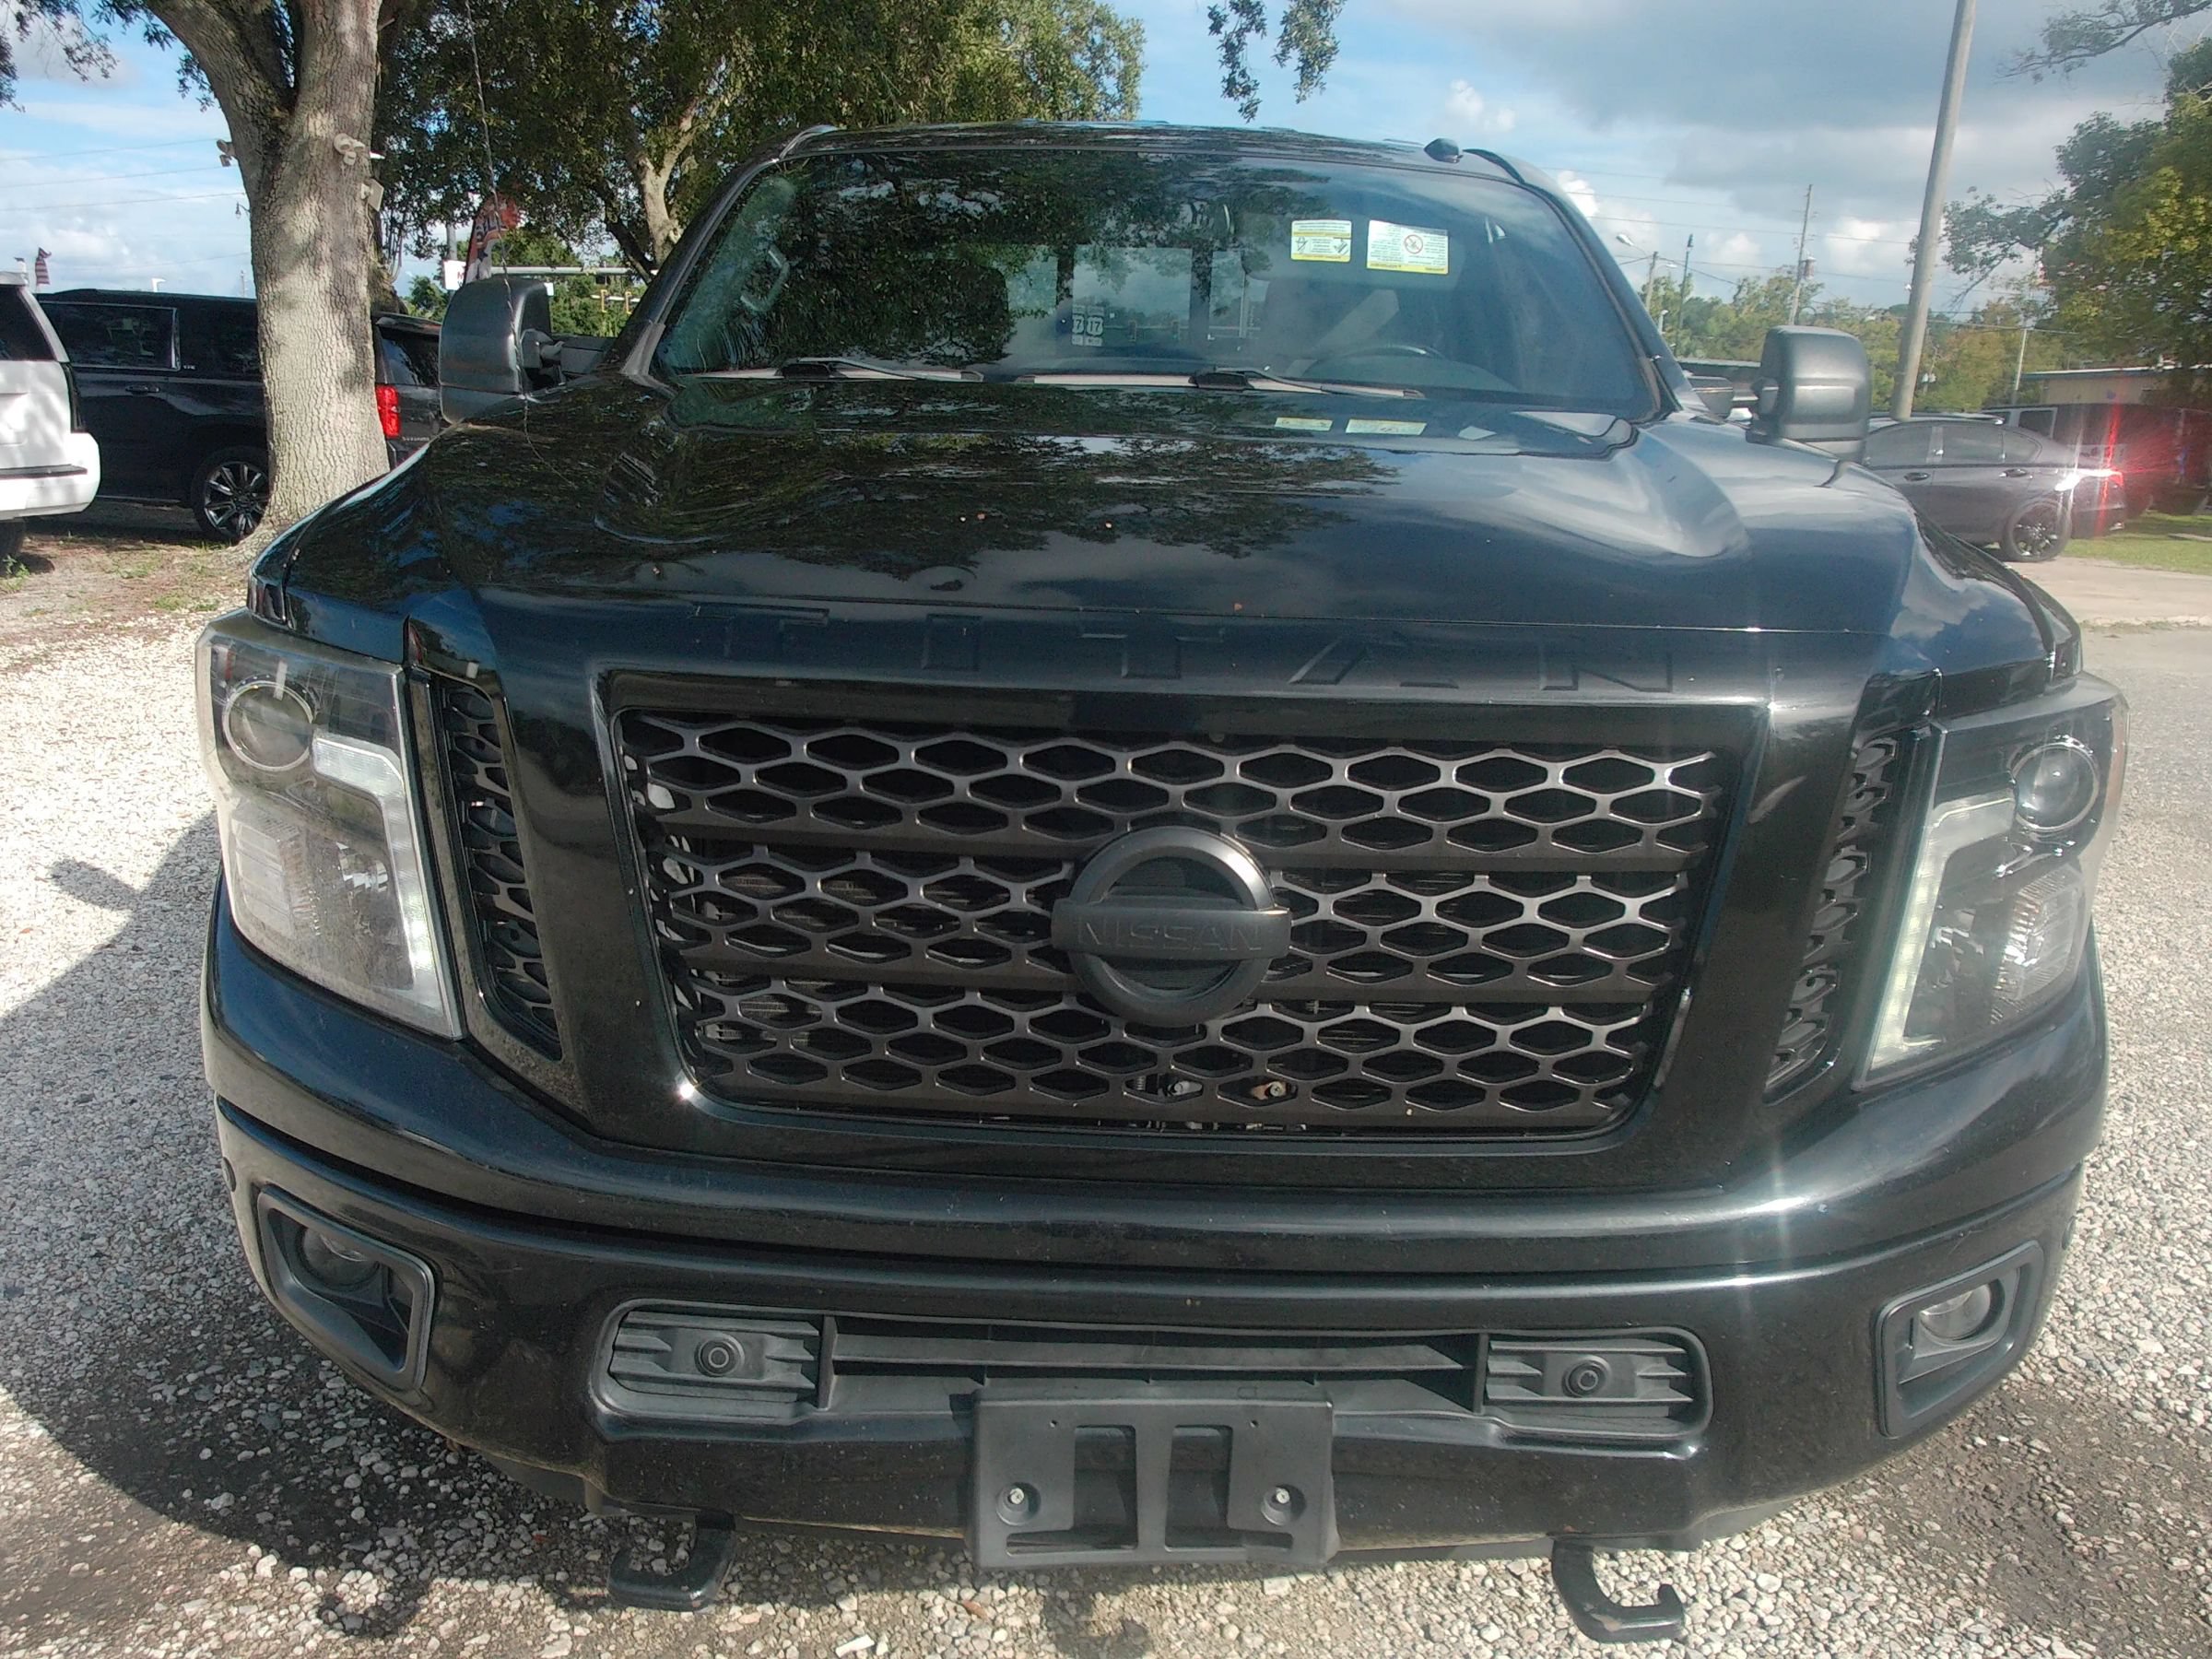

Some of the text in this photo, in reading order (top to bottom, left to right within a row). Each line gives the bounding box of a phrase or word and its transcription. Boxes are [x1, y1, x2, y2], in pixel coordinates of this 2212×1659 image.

[1089, 321, 1101, 333] 17
[689, 601, 1673, 693] TITAN
[1077, 921, 1263, 951] NISSAN
